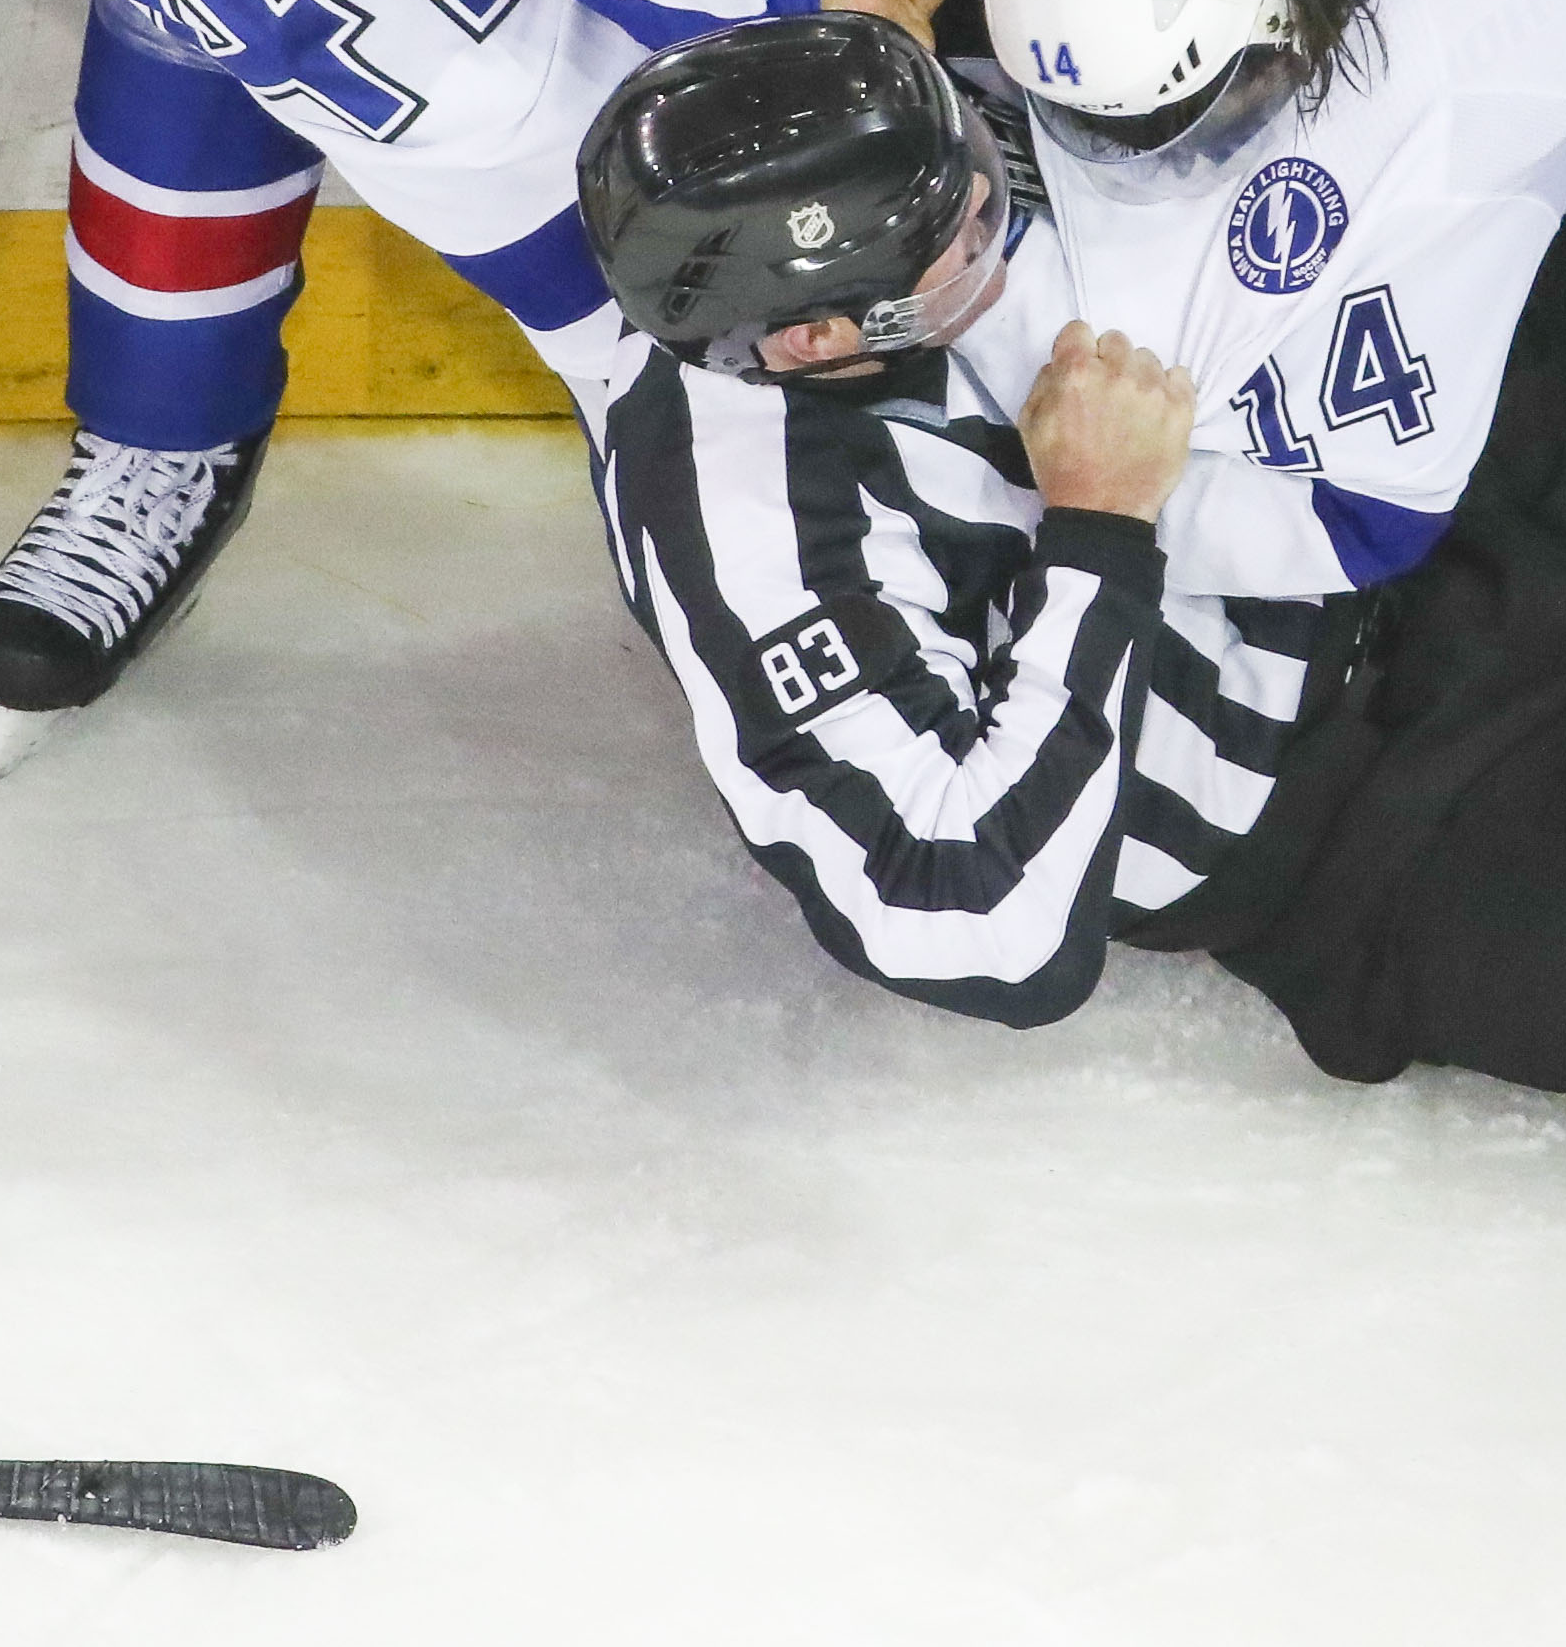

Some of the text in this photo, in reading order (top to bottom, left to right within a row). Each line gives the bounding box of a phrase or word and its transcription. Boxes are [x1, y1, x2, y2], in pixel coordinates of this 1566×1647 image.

[1030, 39, 1082, 86] 14
[1230, 161, 1345, 289] TAMPA BAY LIGHTNING
[1230, 283, 1436, 473] 14
[760, 617, 861, 715] 83
